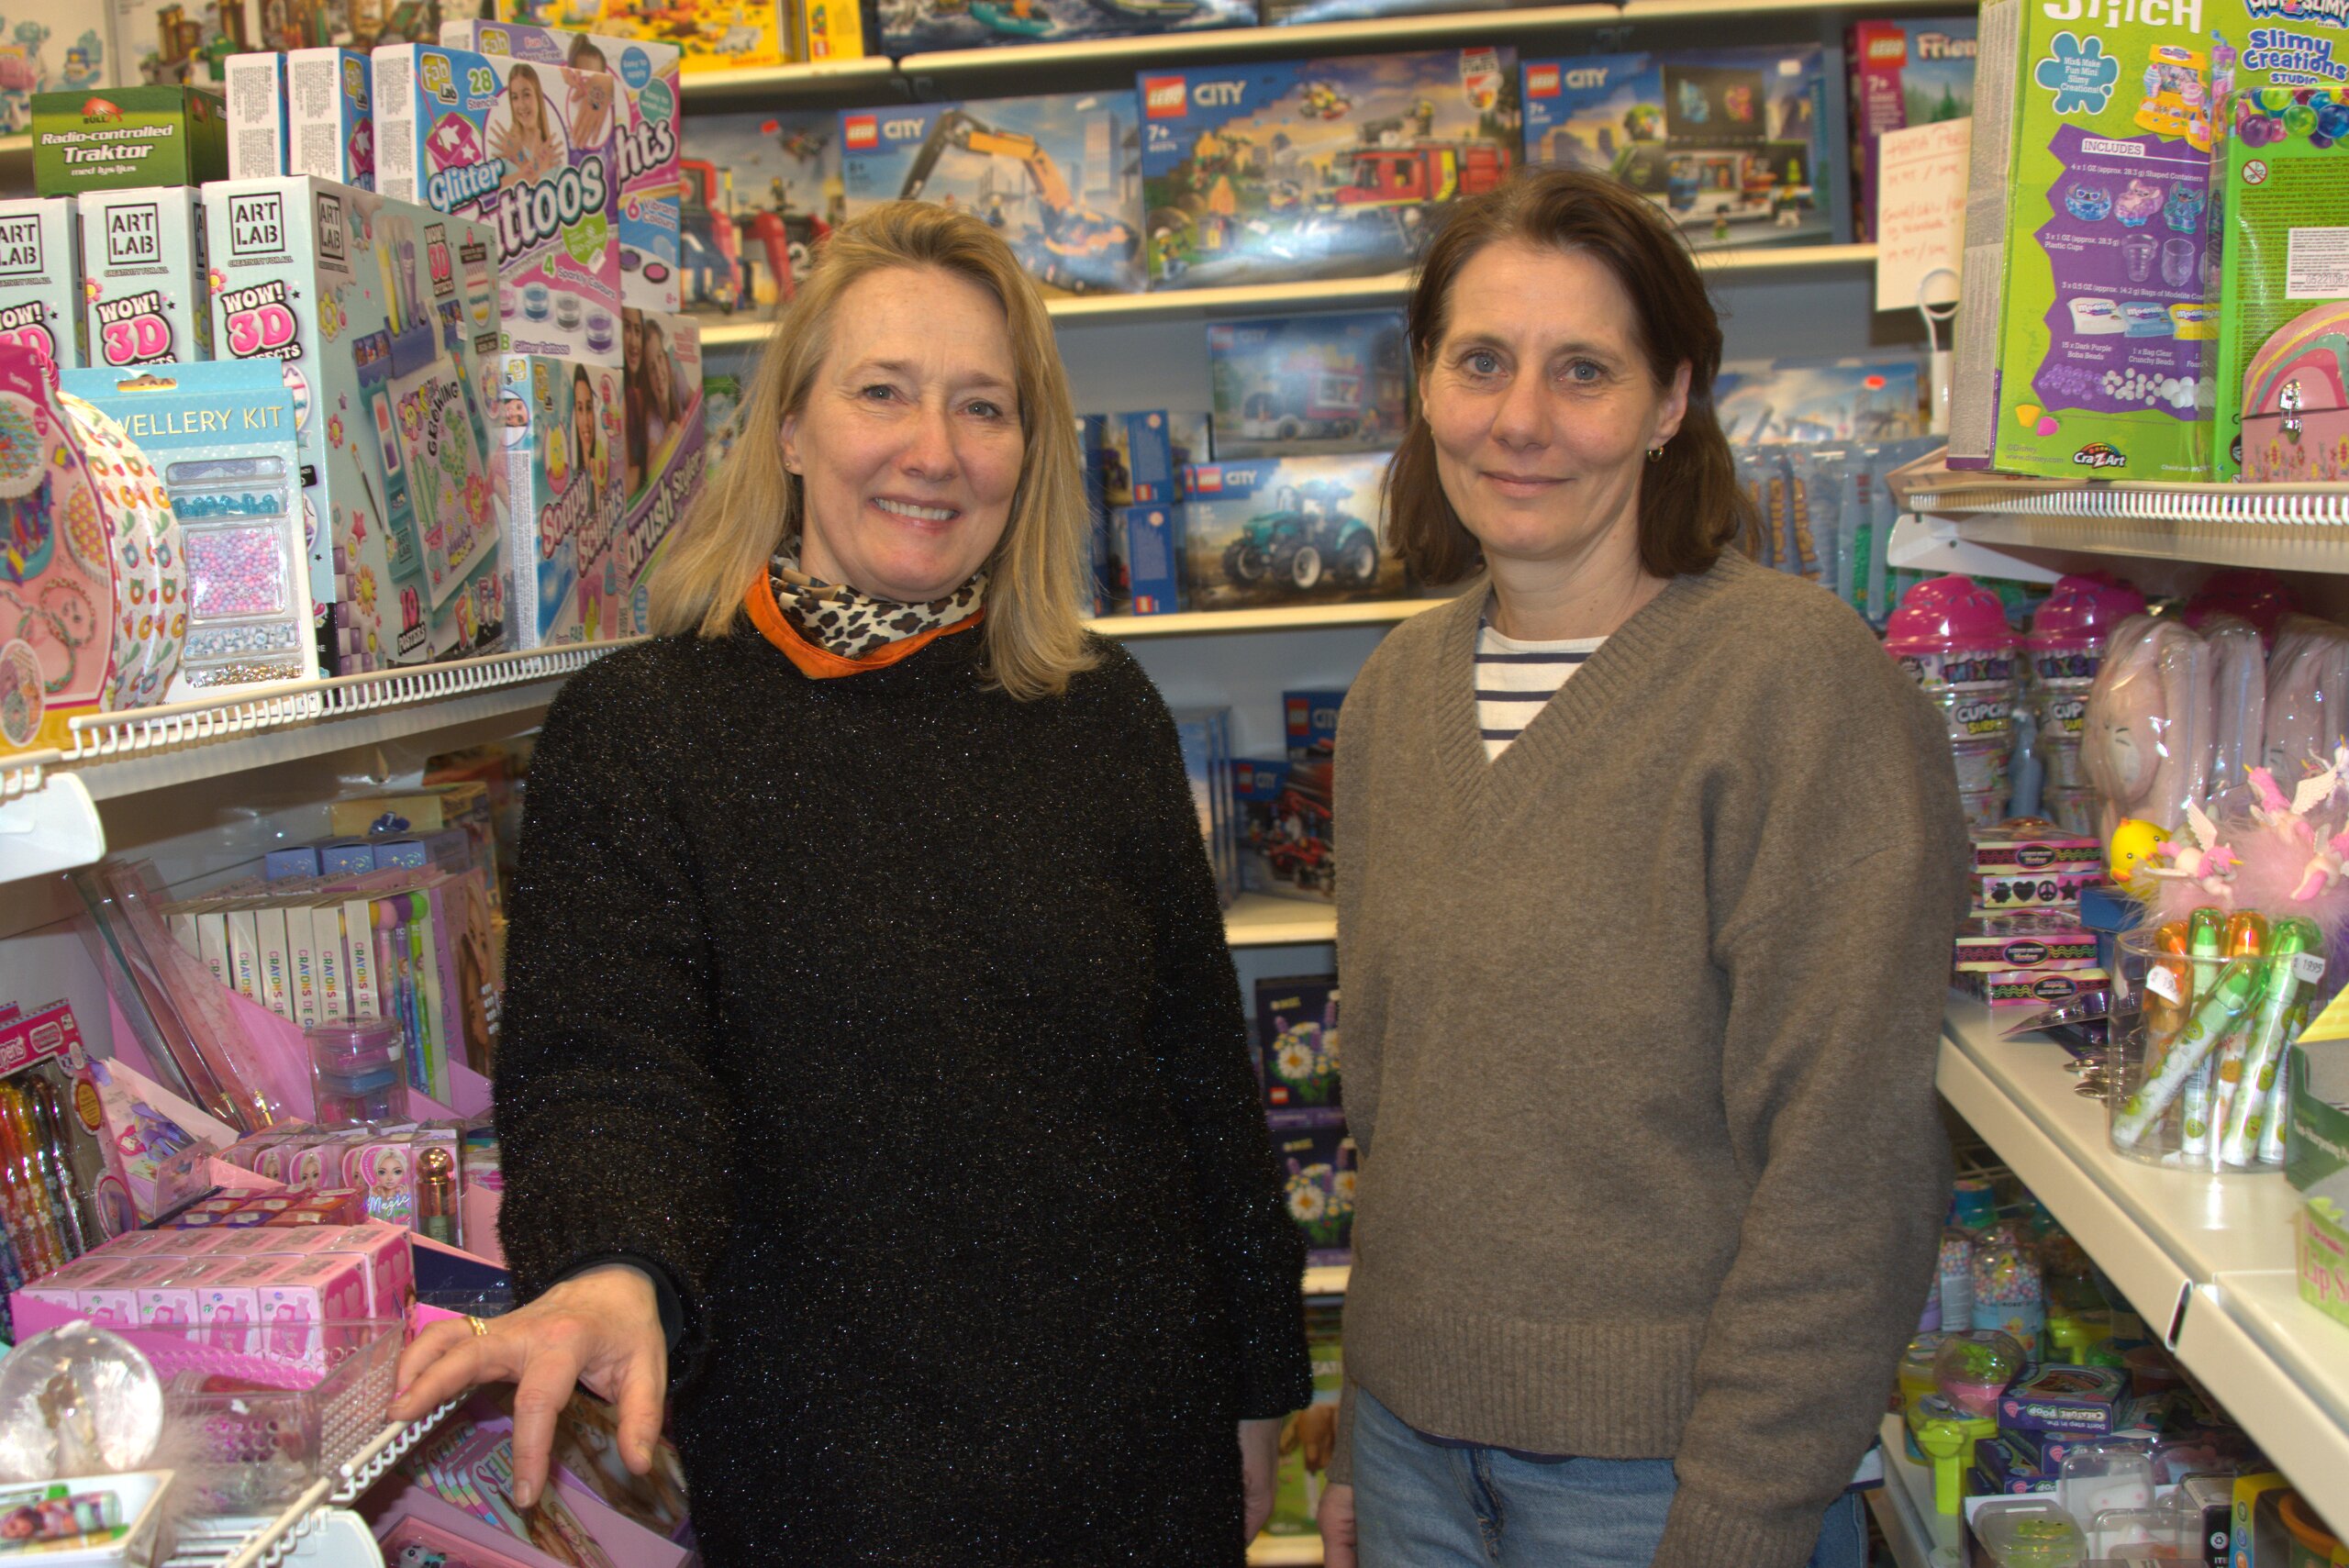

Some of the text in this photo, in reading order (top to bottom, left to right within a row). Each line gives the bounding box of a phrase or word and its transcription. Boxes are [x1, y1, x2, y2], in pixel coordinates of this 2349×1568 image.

[1917, 32, 1977, 59] Frien
[2249, 29, 2332, 61] Slimy
[423, 61, 449, 86] Fab
[2243, 50, 2347, 81] Creations
[468, 68, 494, 93] 28
[1564, 68, 1608, 89] CITY
[467, 97, 499, 109] Stencils
[1150, 81, 1247, 106] LEGO CITY
[41, 125, 173, 145] Radio-controlled
[883, 117, 925, 139] CITY
[63, 143, 153, 163] Traktor
[2084, 140, 2142, 155] INCLUDES
[71, 166, 95, 176] med
[2145, 170, 2168, 181] Shaped
[429, 161, 504, 211] Glitter
[235, 201, 278, 223] ART
[320, 203, 340, 226] ART
[628, 196, 677, 220] 6 Vibrant
[112, 212, 154, 232] ART
[642, 212, 677, 231] Colours
[113, 235, 154, 255] LAB
[236, 225, 279, 246] LAB
[321, 226, 341, 250] LAB
[2044, 241, 2084, 251] Plastic Cups
[104, 267, 140, 277] CREATIVITY
[152, 266, 169, 274] ALL
[228, 257, 265, 268] CREATIVITY
[279, 255, 294, 264] ALL
[428, 241, 451, 279] 3D
[543, 255, 616, 299] 4 Sparkly Colours
[97, 292, 159, 323] WOW!
[222, 281, 285, 313] WOW!
[0, 304, 44, 325] OW!
[105, 316, 169, 363] 3D
[228, 304, 295, 352] 3D
[2075, 341, 2090, 351] Dark
[116, 406, 284, 437] WELLERY KIT
[1226, 470, 1257, 486] CITY
[541, 469, 589, 559] Soapy
[400, 585, 420, 630] 10
[397, 623, 426, 655] POSTERS
[239, 951, 253, 998] CRAYONS
[269, 951, 284, 998] CRAYONS
[298, 950, 313, 1015] CRAYONS DE
[323, 951, 339, 1016] CRAYONS DE
[355, 941, 370, 1007] CRAYONS DE
[367, 1193, 411, 1218] Magic
[2304, 1244, 2332, 1302] Lip
[2029, 1407, 2104, 1420] CREATURE POOP
[2069, 1420, 2085, 1429] step
